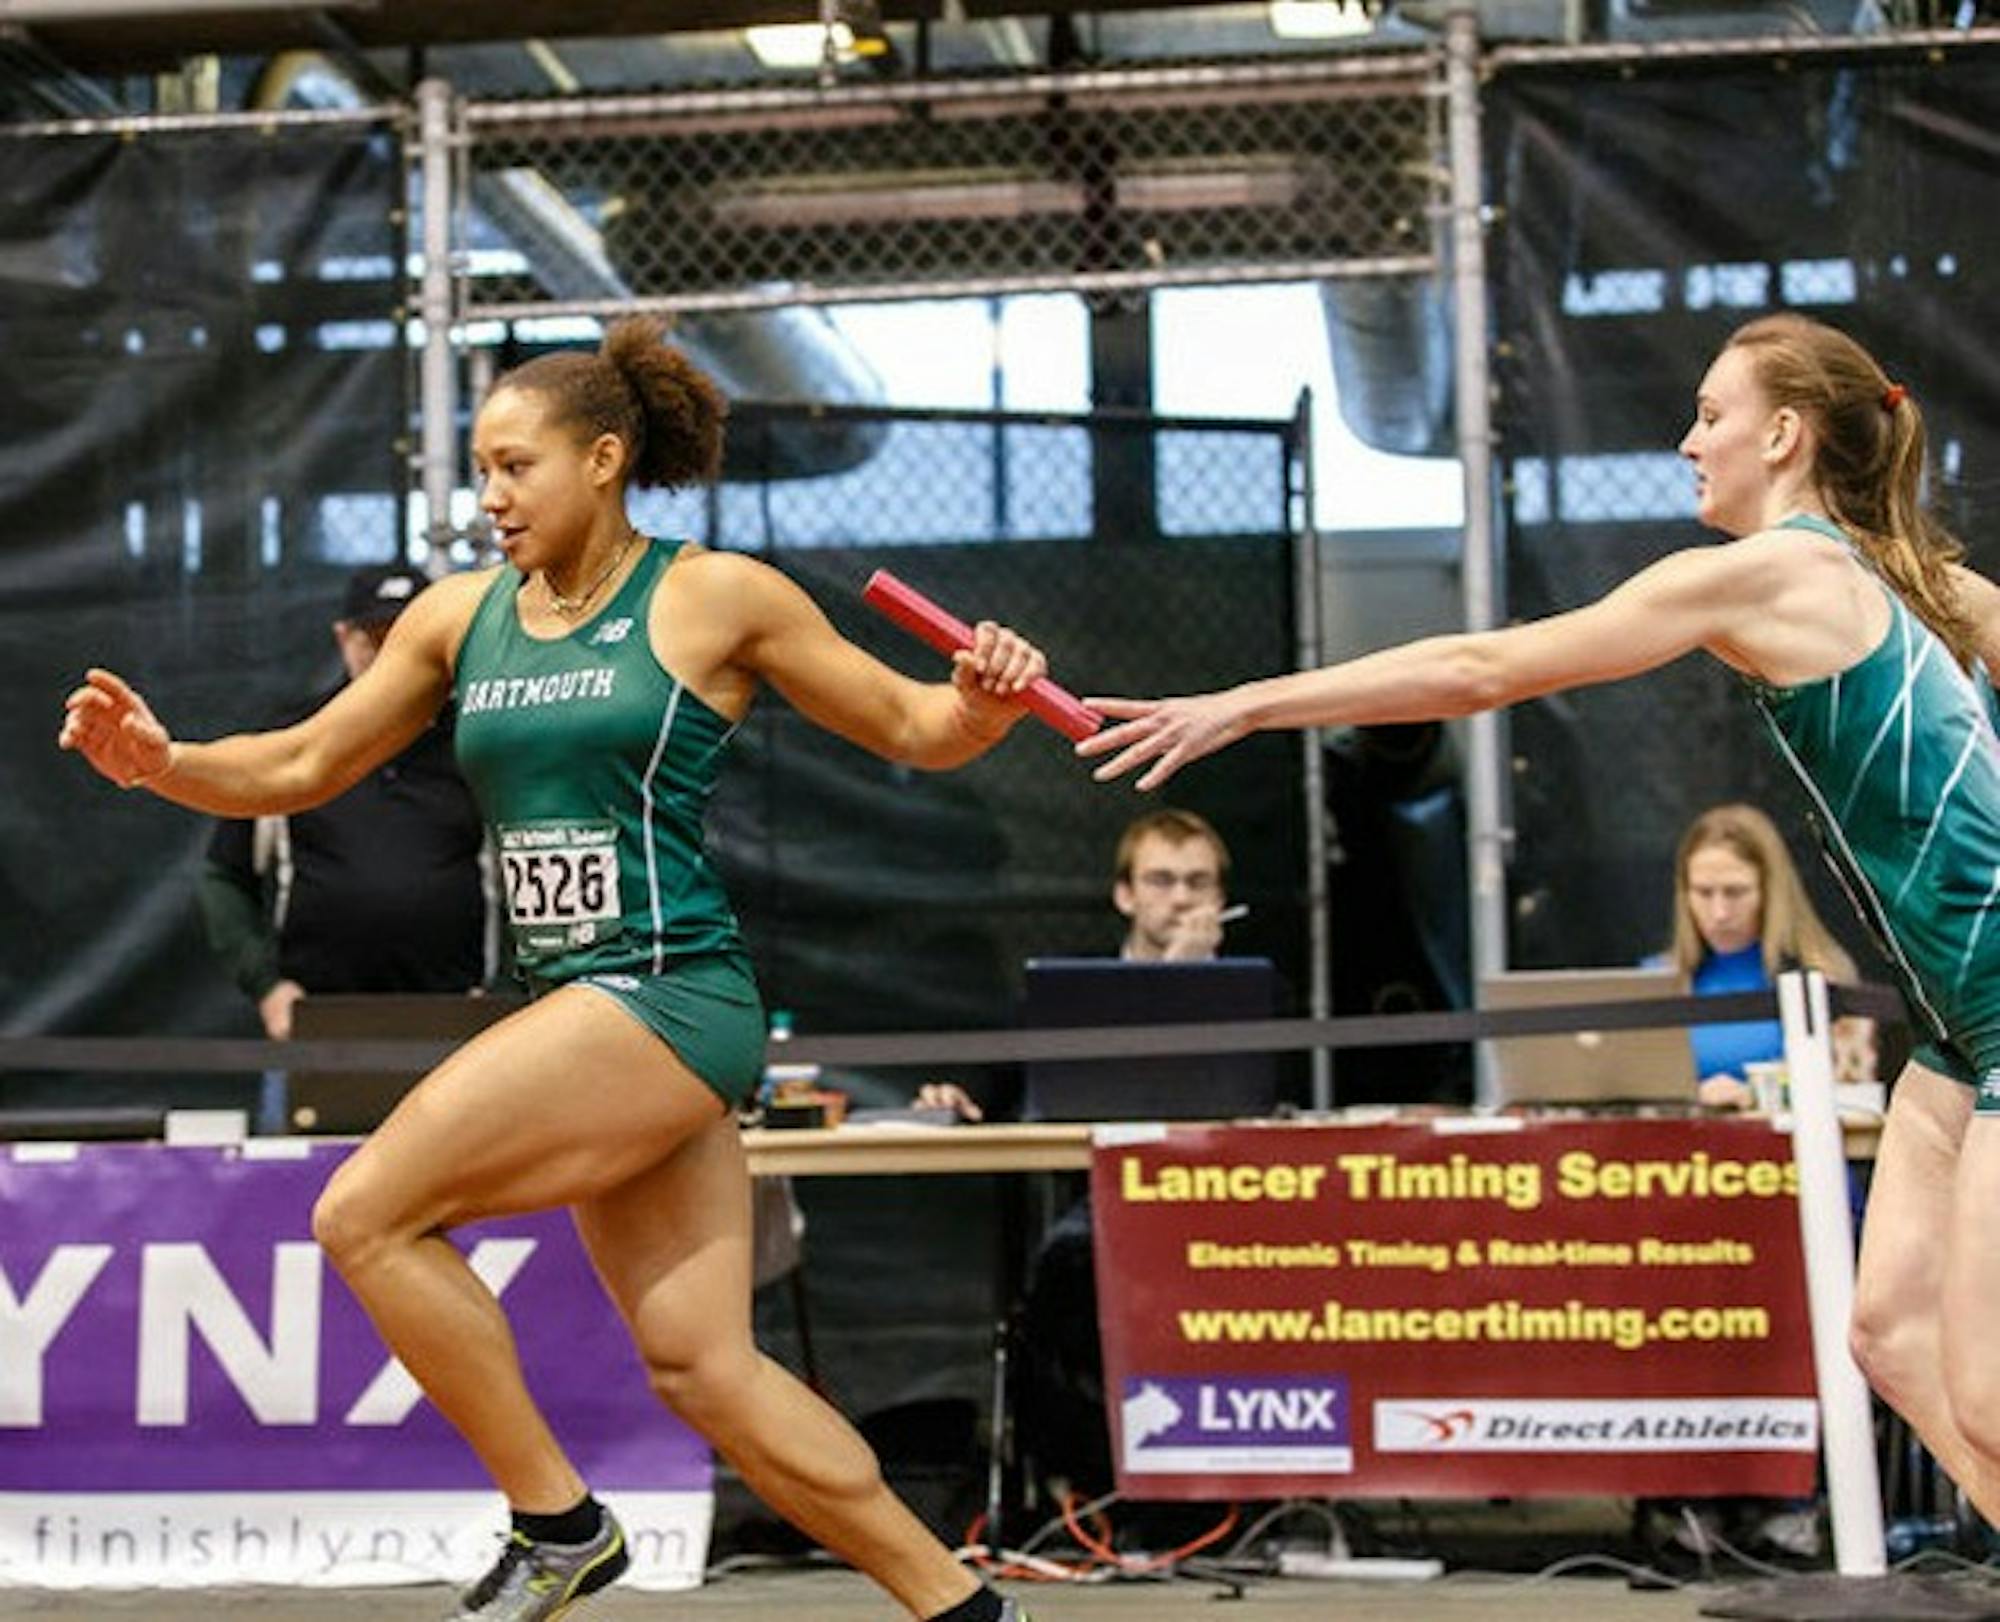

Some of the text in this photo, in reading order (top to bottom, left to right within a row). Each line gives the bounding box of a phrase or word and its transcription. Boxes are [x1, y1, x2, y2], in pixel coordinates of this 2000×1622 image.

[462, 669, 616, 714] DARTMOUTH
[507, 854, 605, 917] 2526
[1122, 1151, 1801, 1209] Lancer Timing Services
[1188, 1238, 1754, 1272] Electronic Timing & Real-time Results
[1179, 1300, 1770, 1350] www.lancertiming.com
[1200, 1386, 1336, 1432] LYNX
